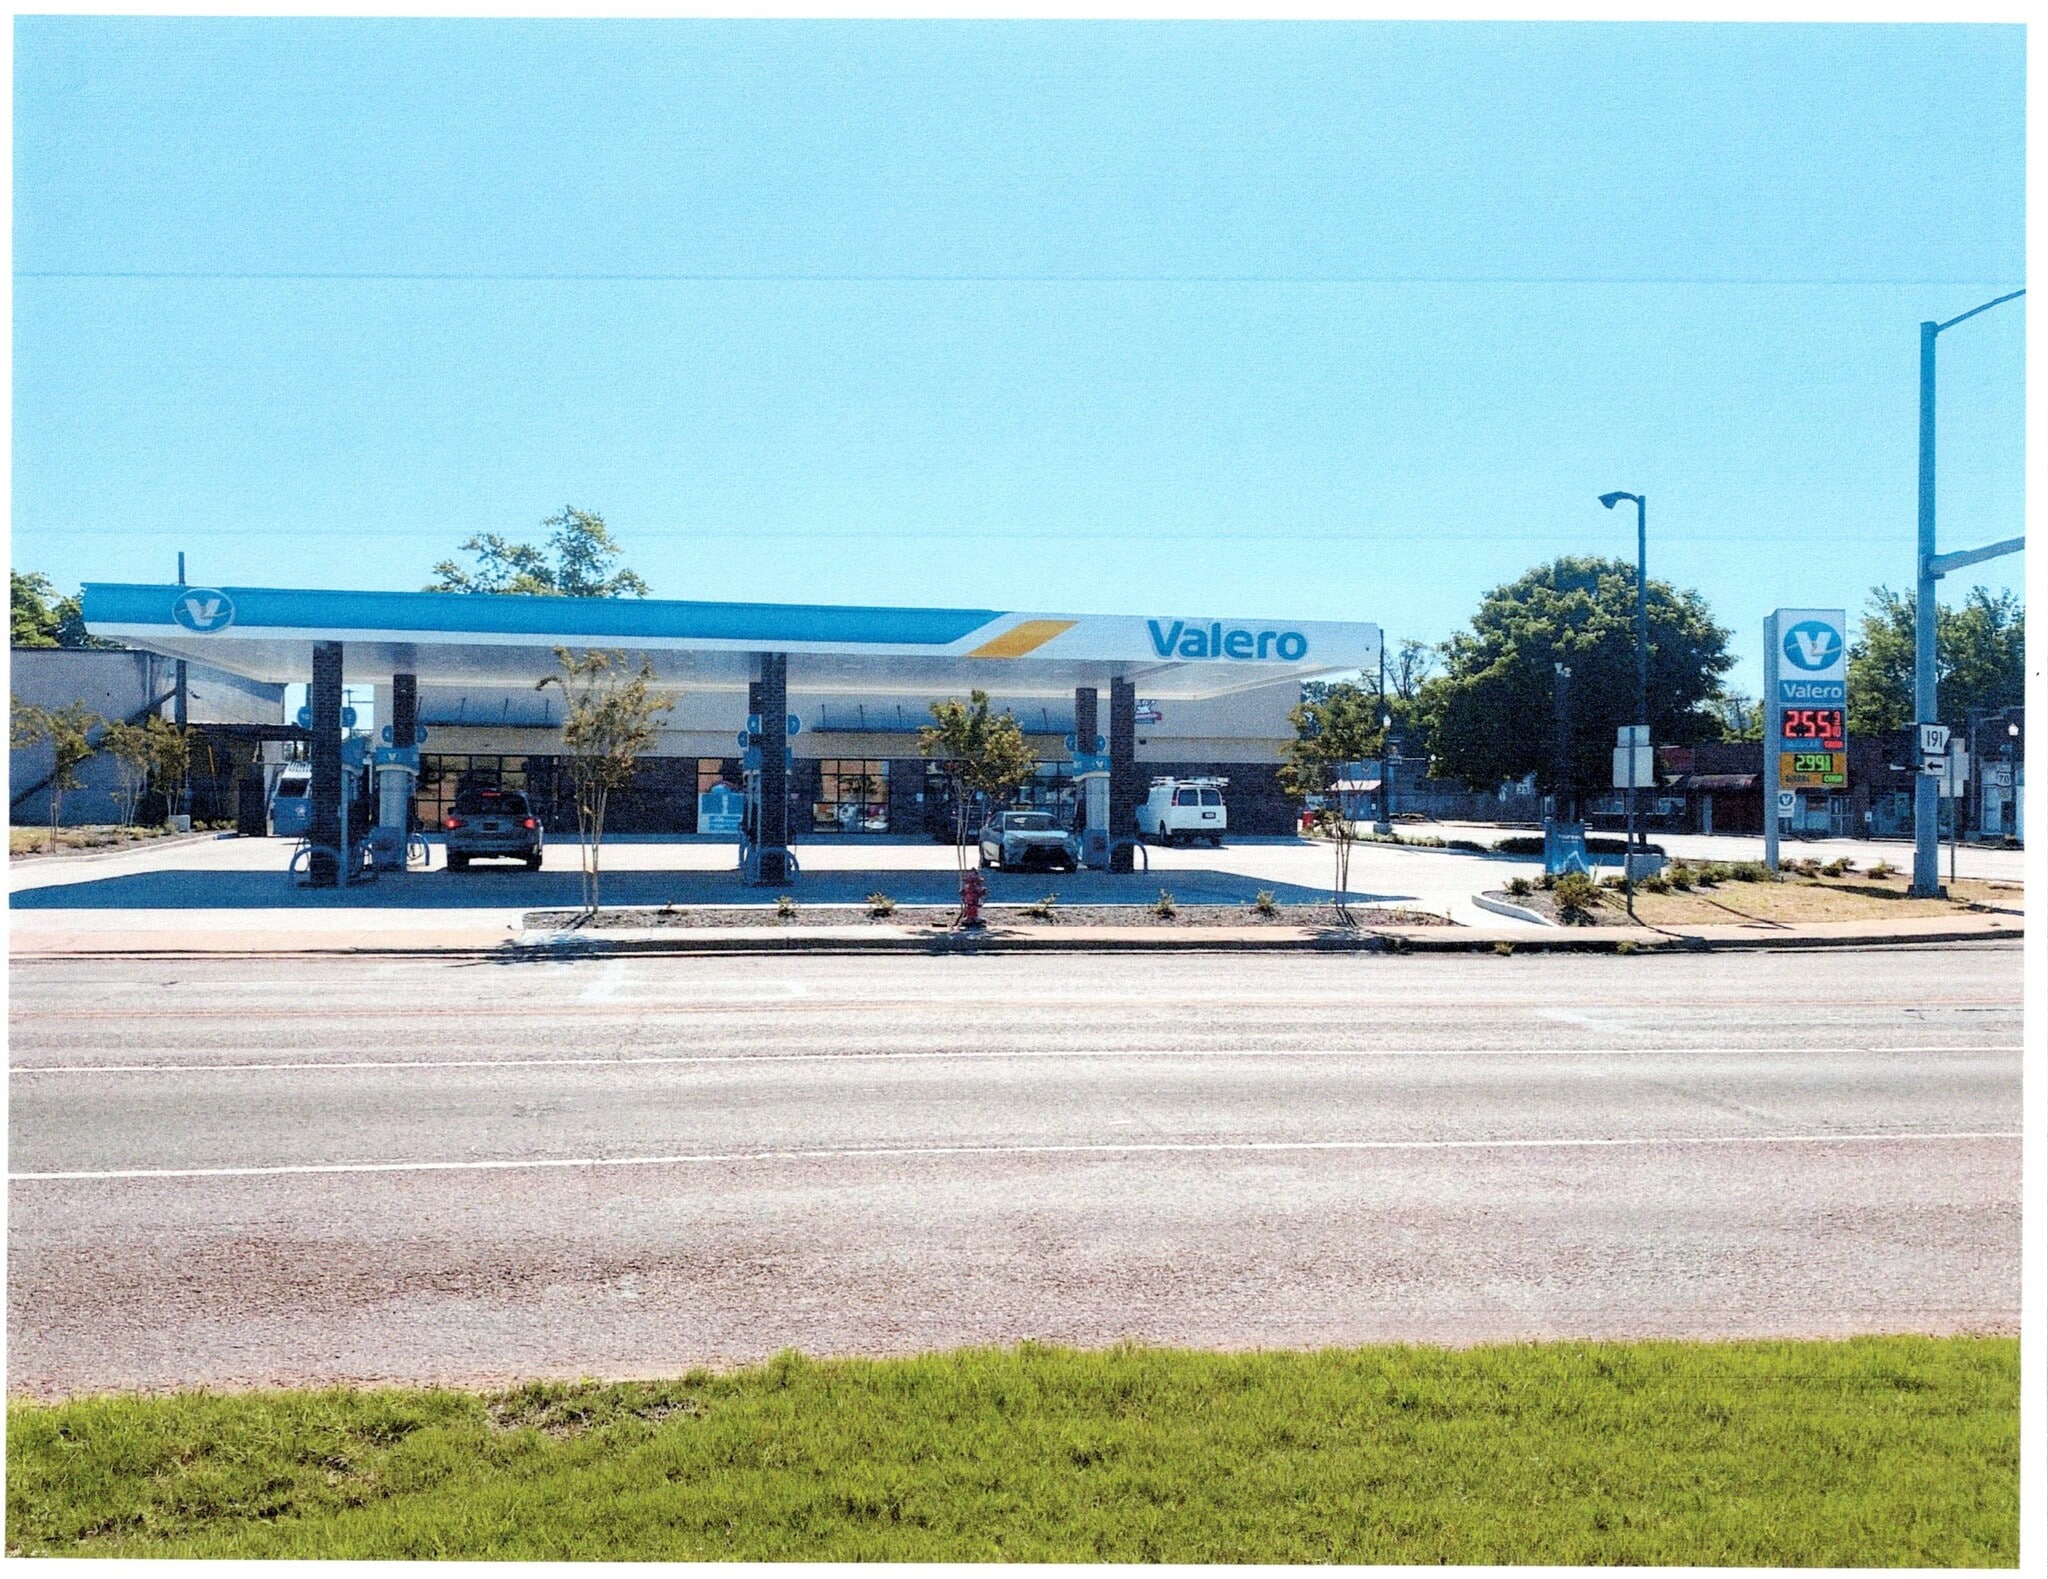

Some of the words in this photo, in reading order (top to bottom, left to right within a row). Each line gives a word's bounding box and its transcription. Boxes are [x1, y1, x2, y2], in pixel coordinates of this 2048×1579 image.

[1147, 619, 1308, 661] Valero
[1783, 683, 1842, 699] Valero
[1926, 730, 1943, 748] 191
